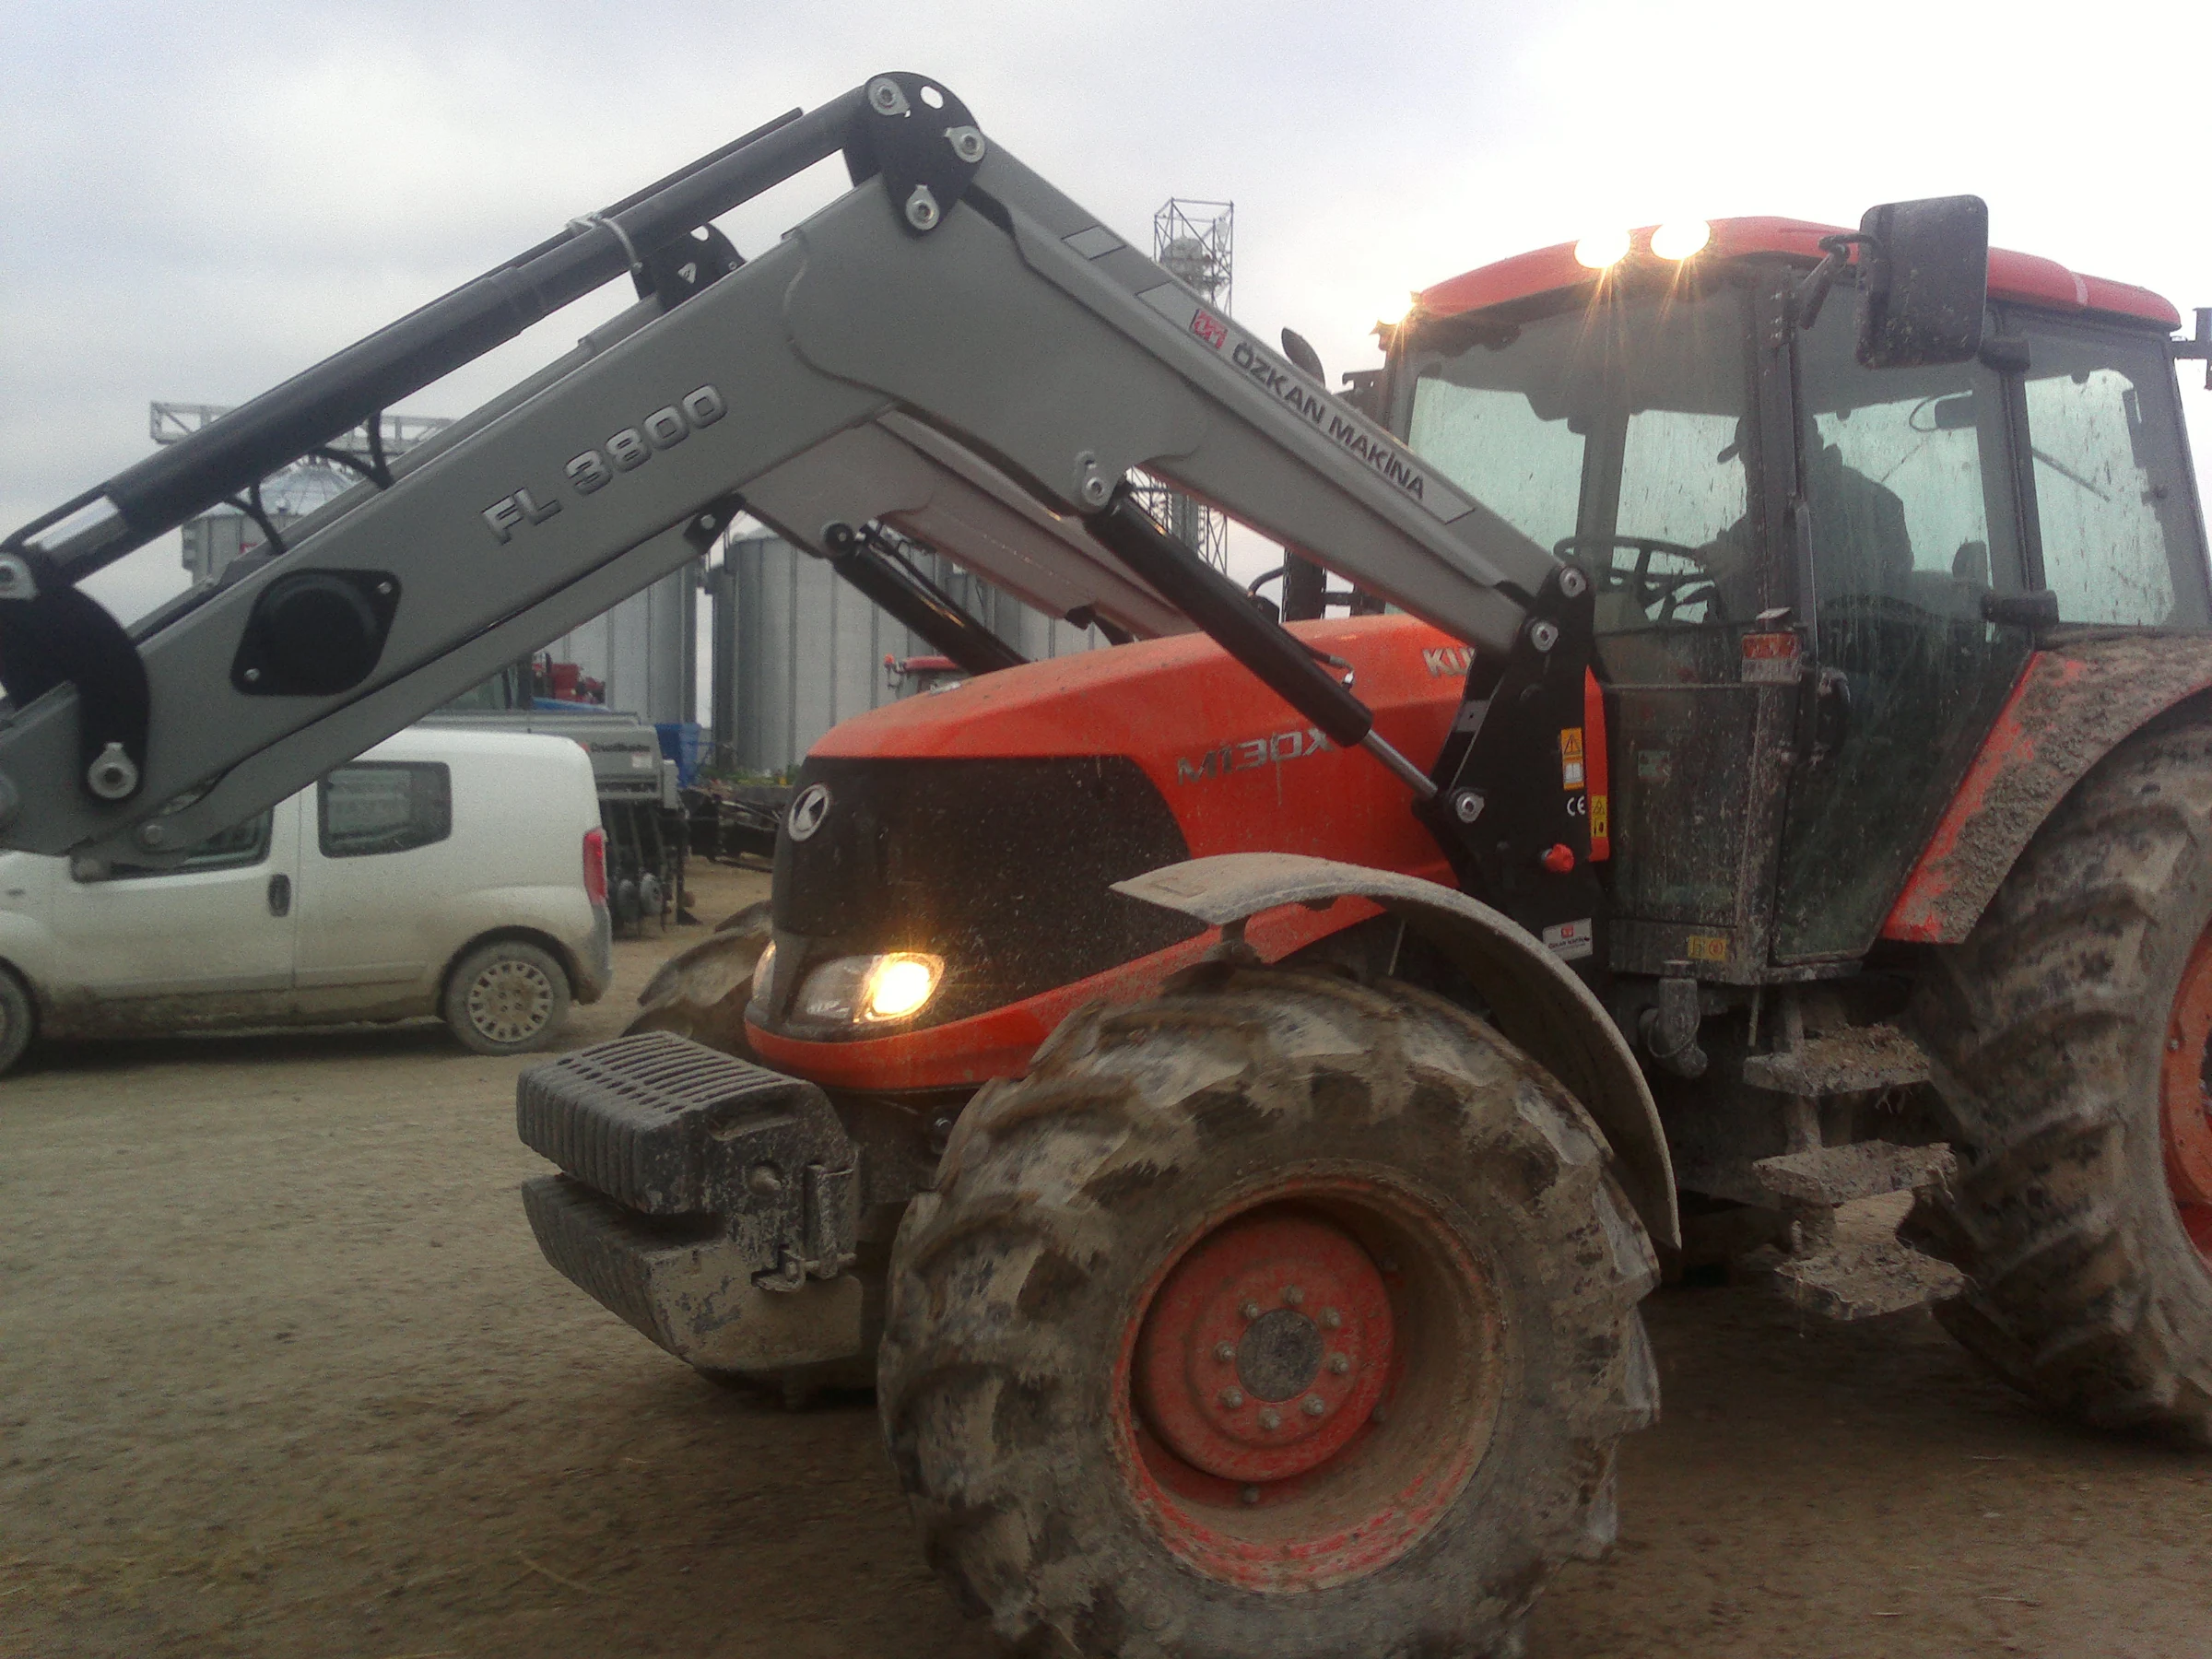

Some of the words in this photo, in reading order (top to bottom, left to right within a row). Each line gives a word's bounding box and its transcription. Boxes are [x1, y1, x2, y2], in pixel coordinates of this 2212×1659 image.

[1232, 341, 1325, 423] ÖZKAN
[481, 487, 563, 546] FL
[563, 383, 728, 497] 3800
[1177, 727, 1335, 786] M130X
[1567, 795, 1586, 817] CE
